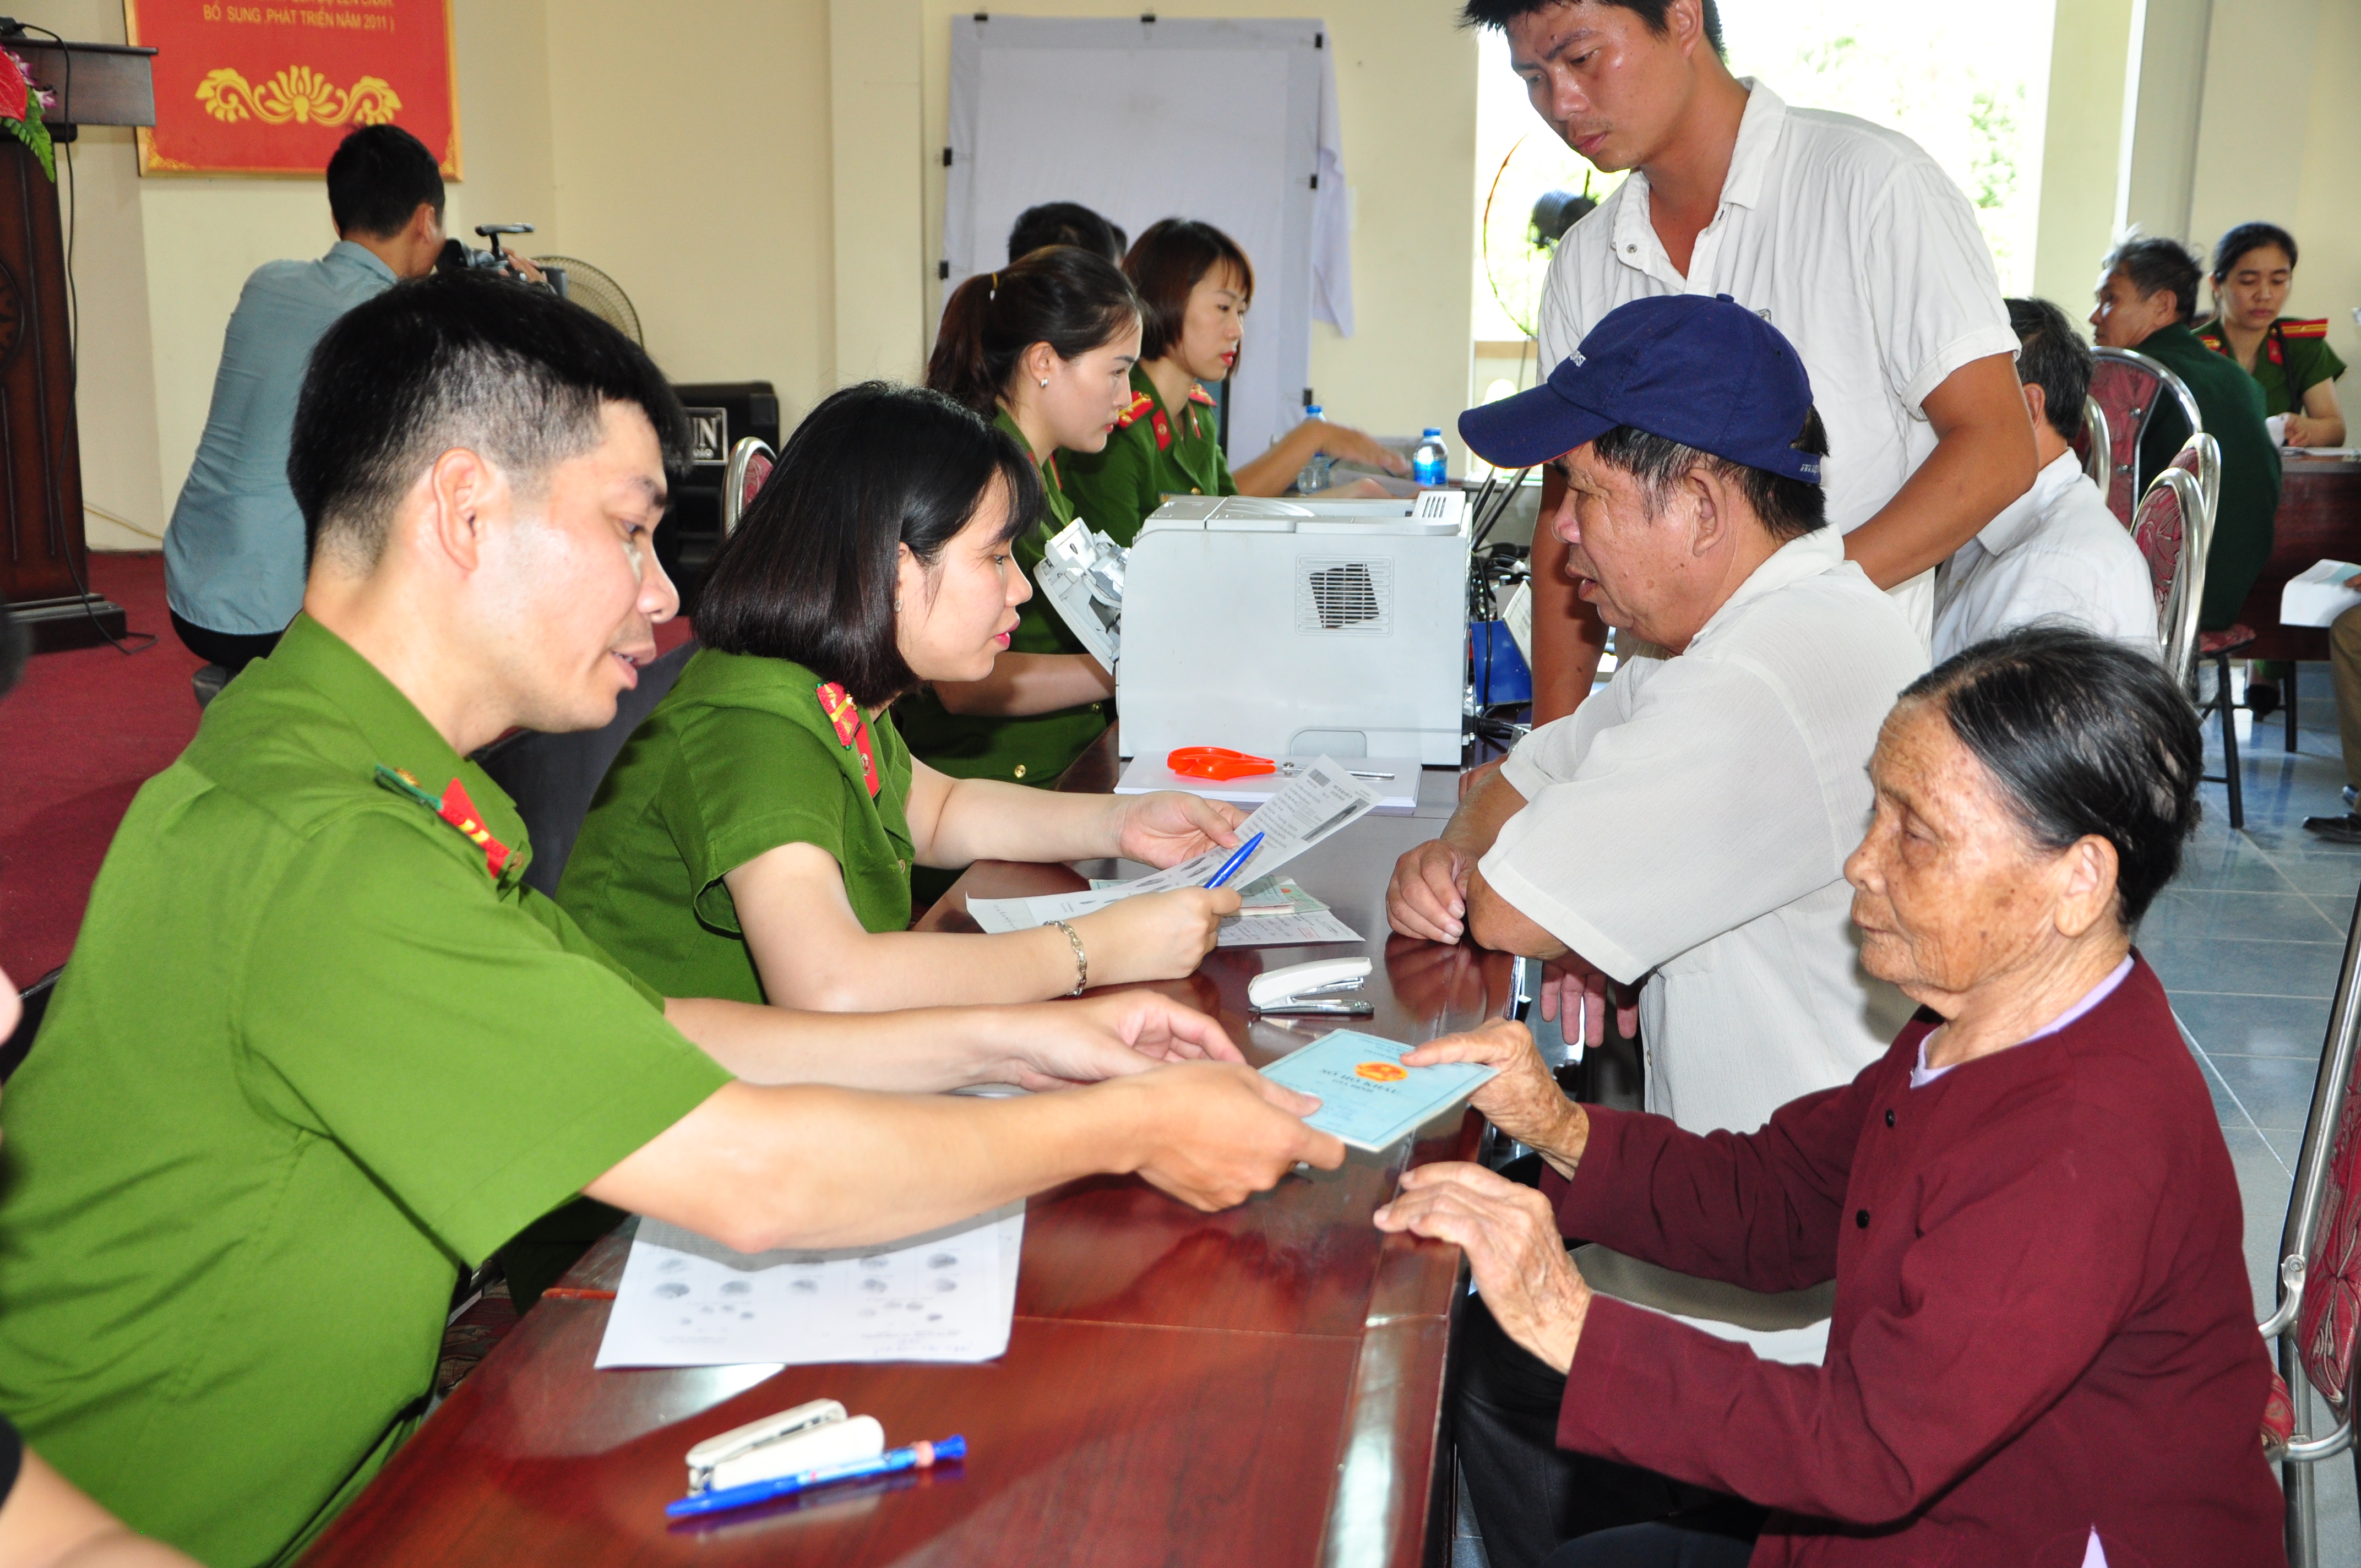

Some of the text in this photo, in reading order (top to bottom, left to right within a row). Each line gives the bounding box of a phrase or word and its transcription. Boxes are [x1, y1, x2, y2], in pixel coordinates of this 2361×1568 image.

[227, 5, 261, 24] SUNG
[335, 10, 361, 29] NĂM
[363, 13, 387, 30] 2011
[389, 15, 395, 34] )
